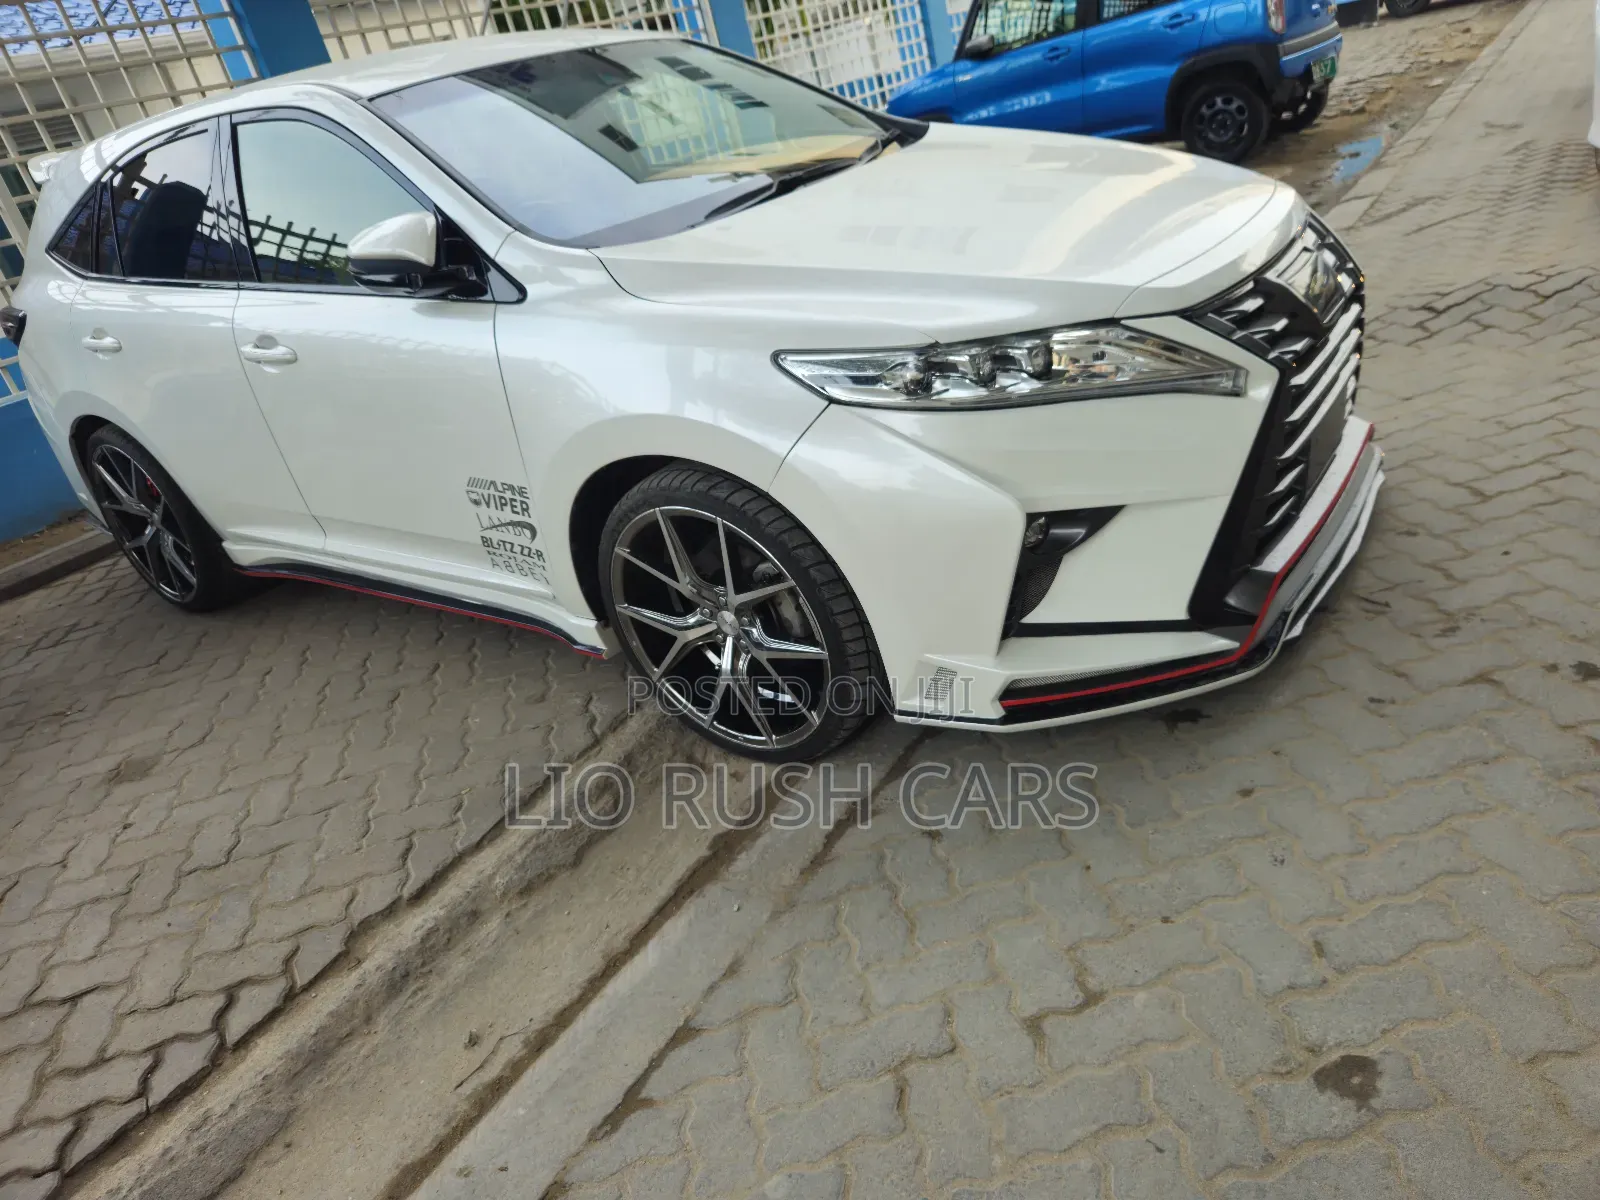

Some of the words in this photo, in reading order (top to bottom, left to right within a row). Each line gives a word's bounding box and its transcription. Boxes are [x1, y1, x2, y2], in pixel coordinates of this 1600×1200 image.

[485, 479, 530, 500] ALPINE
[481, 493, 532, 518] VIPER
[480, 536, 517, 555] BLITZ
